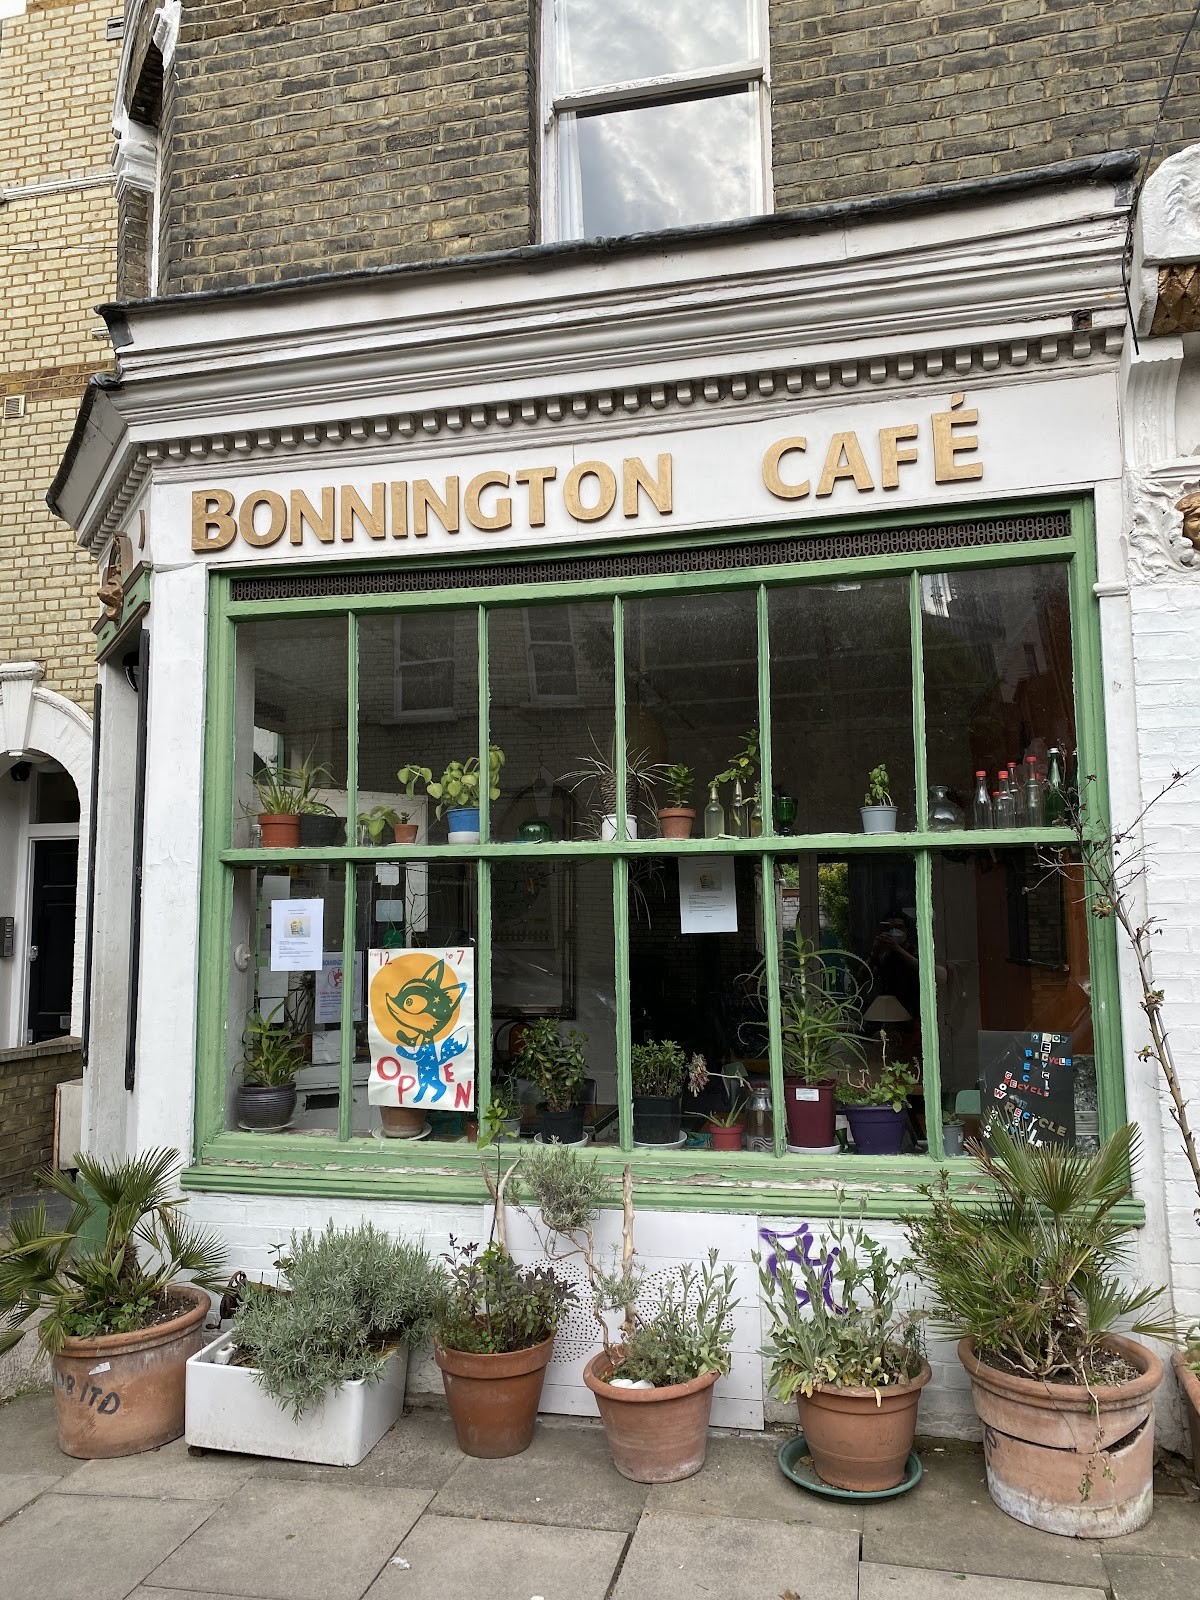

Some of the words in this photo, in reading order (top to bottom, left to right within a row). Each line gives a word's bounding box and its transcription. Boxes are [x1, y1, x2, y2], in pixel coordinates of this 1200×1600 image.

[191, 453, 674, 553] BONNINGTON
[761, 392, 983, 501] CAFÉ
[379, 951, 392, 966] 12
[456, 949, 465, 965] 7
[377, 1056, 471, 1108] OPEN
